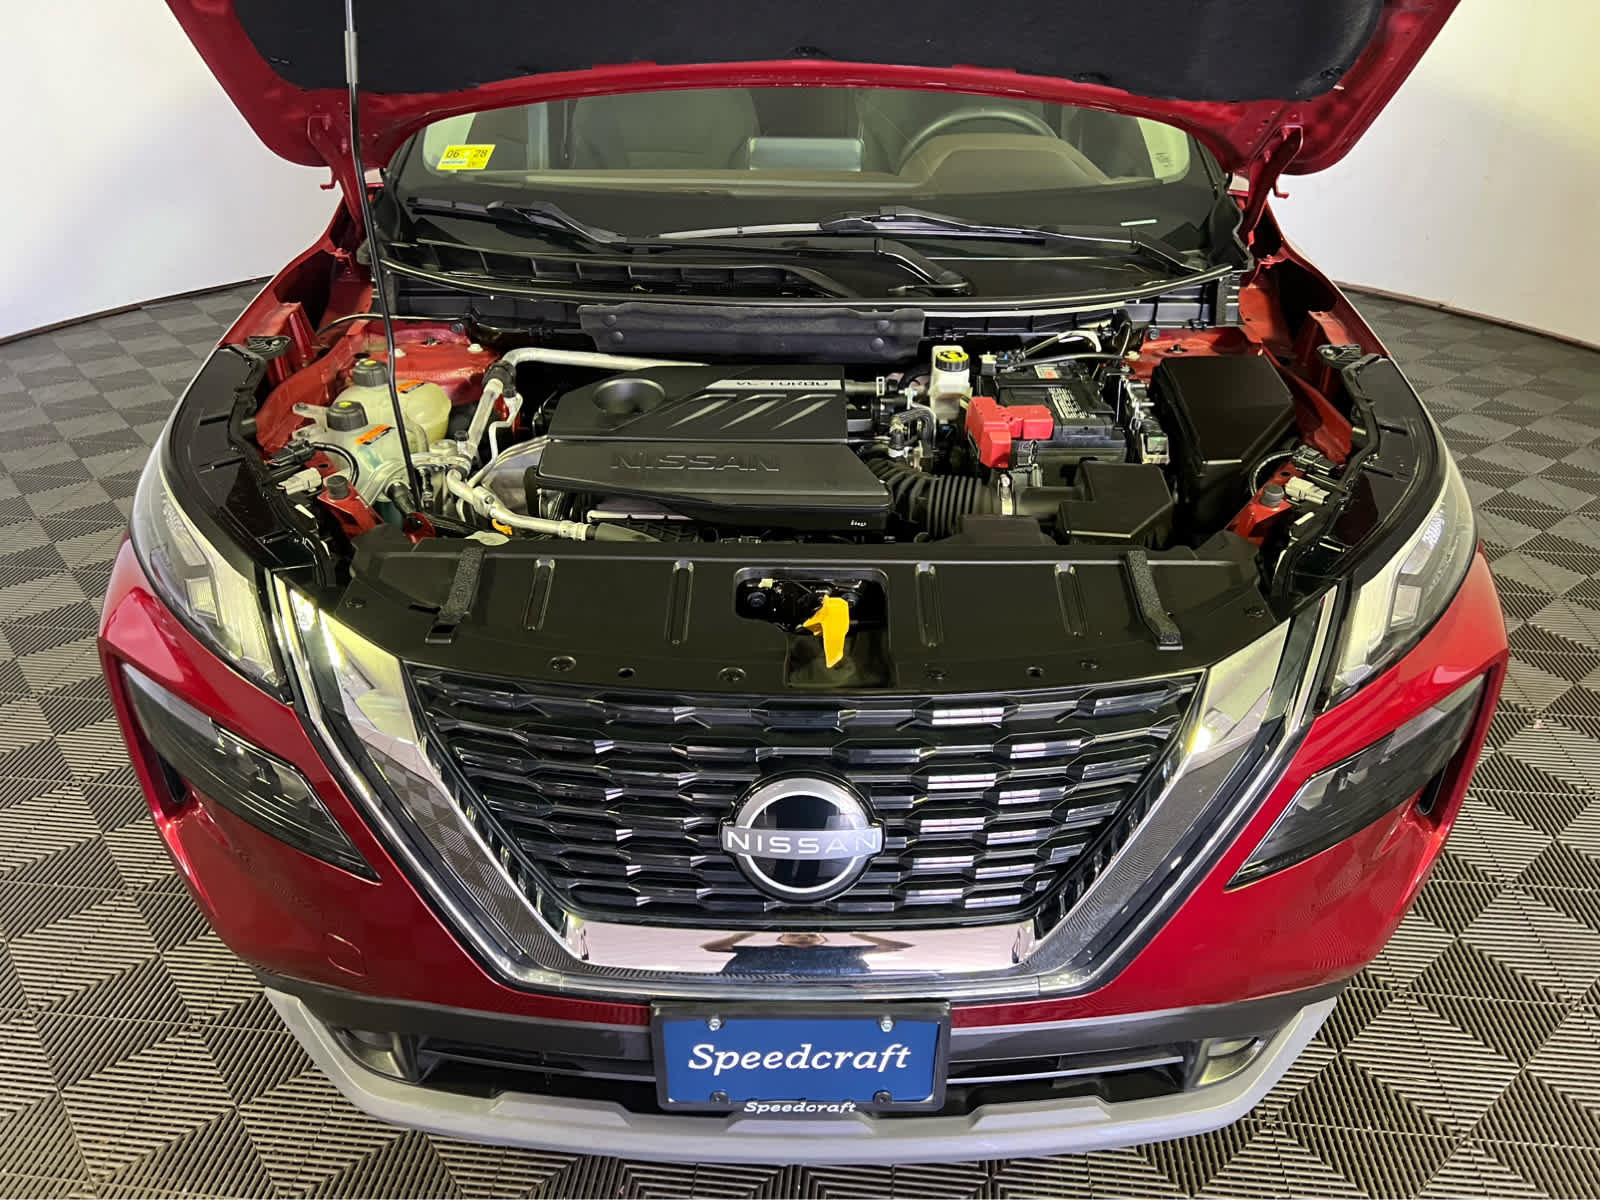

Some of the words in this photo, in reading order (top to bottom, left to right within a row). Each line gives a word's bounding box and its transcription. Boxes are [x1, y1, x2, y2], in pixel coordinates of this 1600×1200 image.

[609, 454, 781, 472] NISSAN
[727, 830, 877, 855] NISSAN
[687, 1043, 912, 1077] Speedcraft
[743, 1101, 857, 1115] Speedcraft
